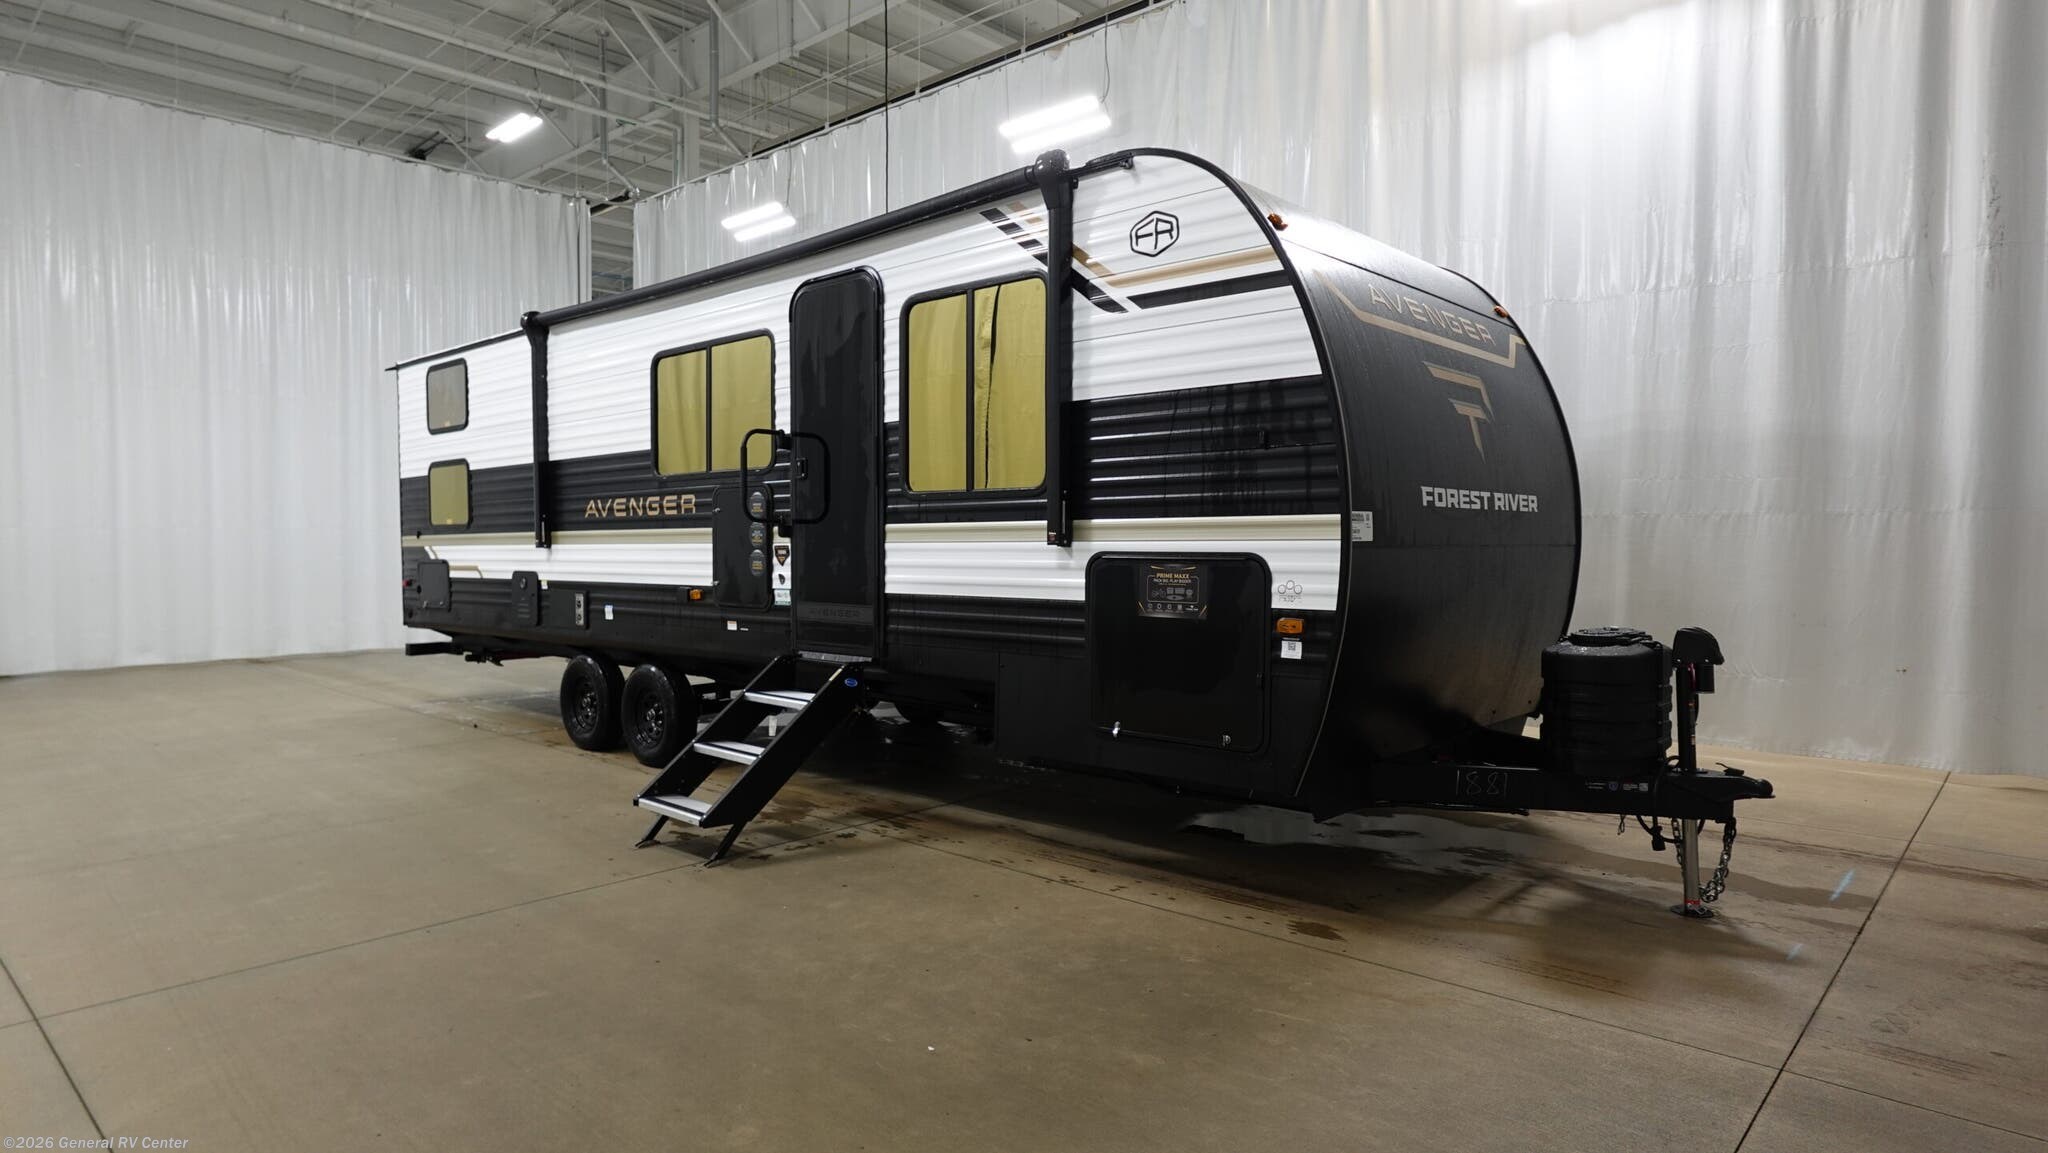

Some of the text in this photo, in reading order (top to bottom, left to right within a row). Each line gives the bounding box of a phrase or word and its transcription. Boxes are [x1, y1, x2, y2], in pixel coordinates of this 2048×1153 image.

[1368, 283, 1497, 346] AVENGER
[584, 493, 696, 518] AVENGER
[1420, 486, 1539, 513] FOREST RIVER
